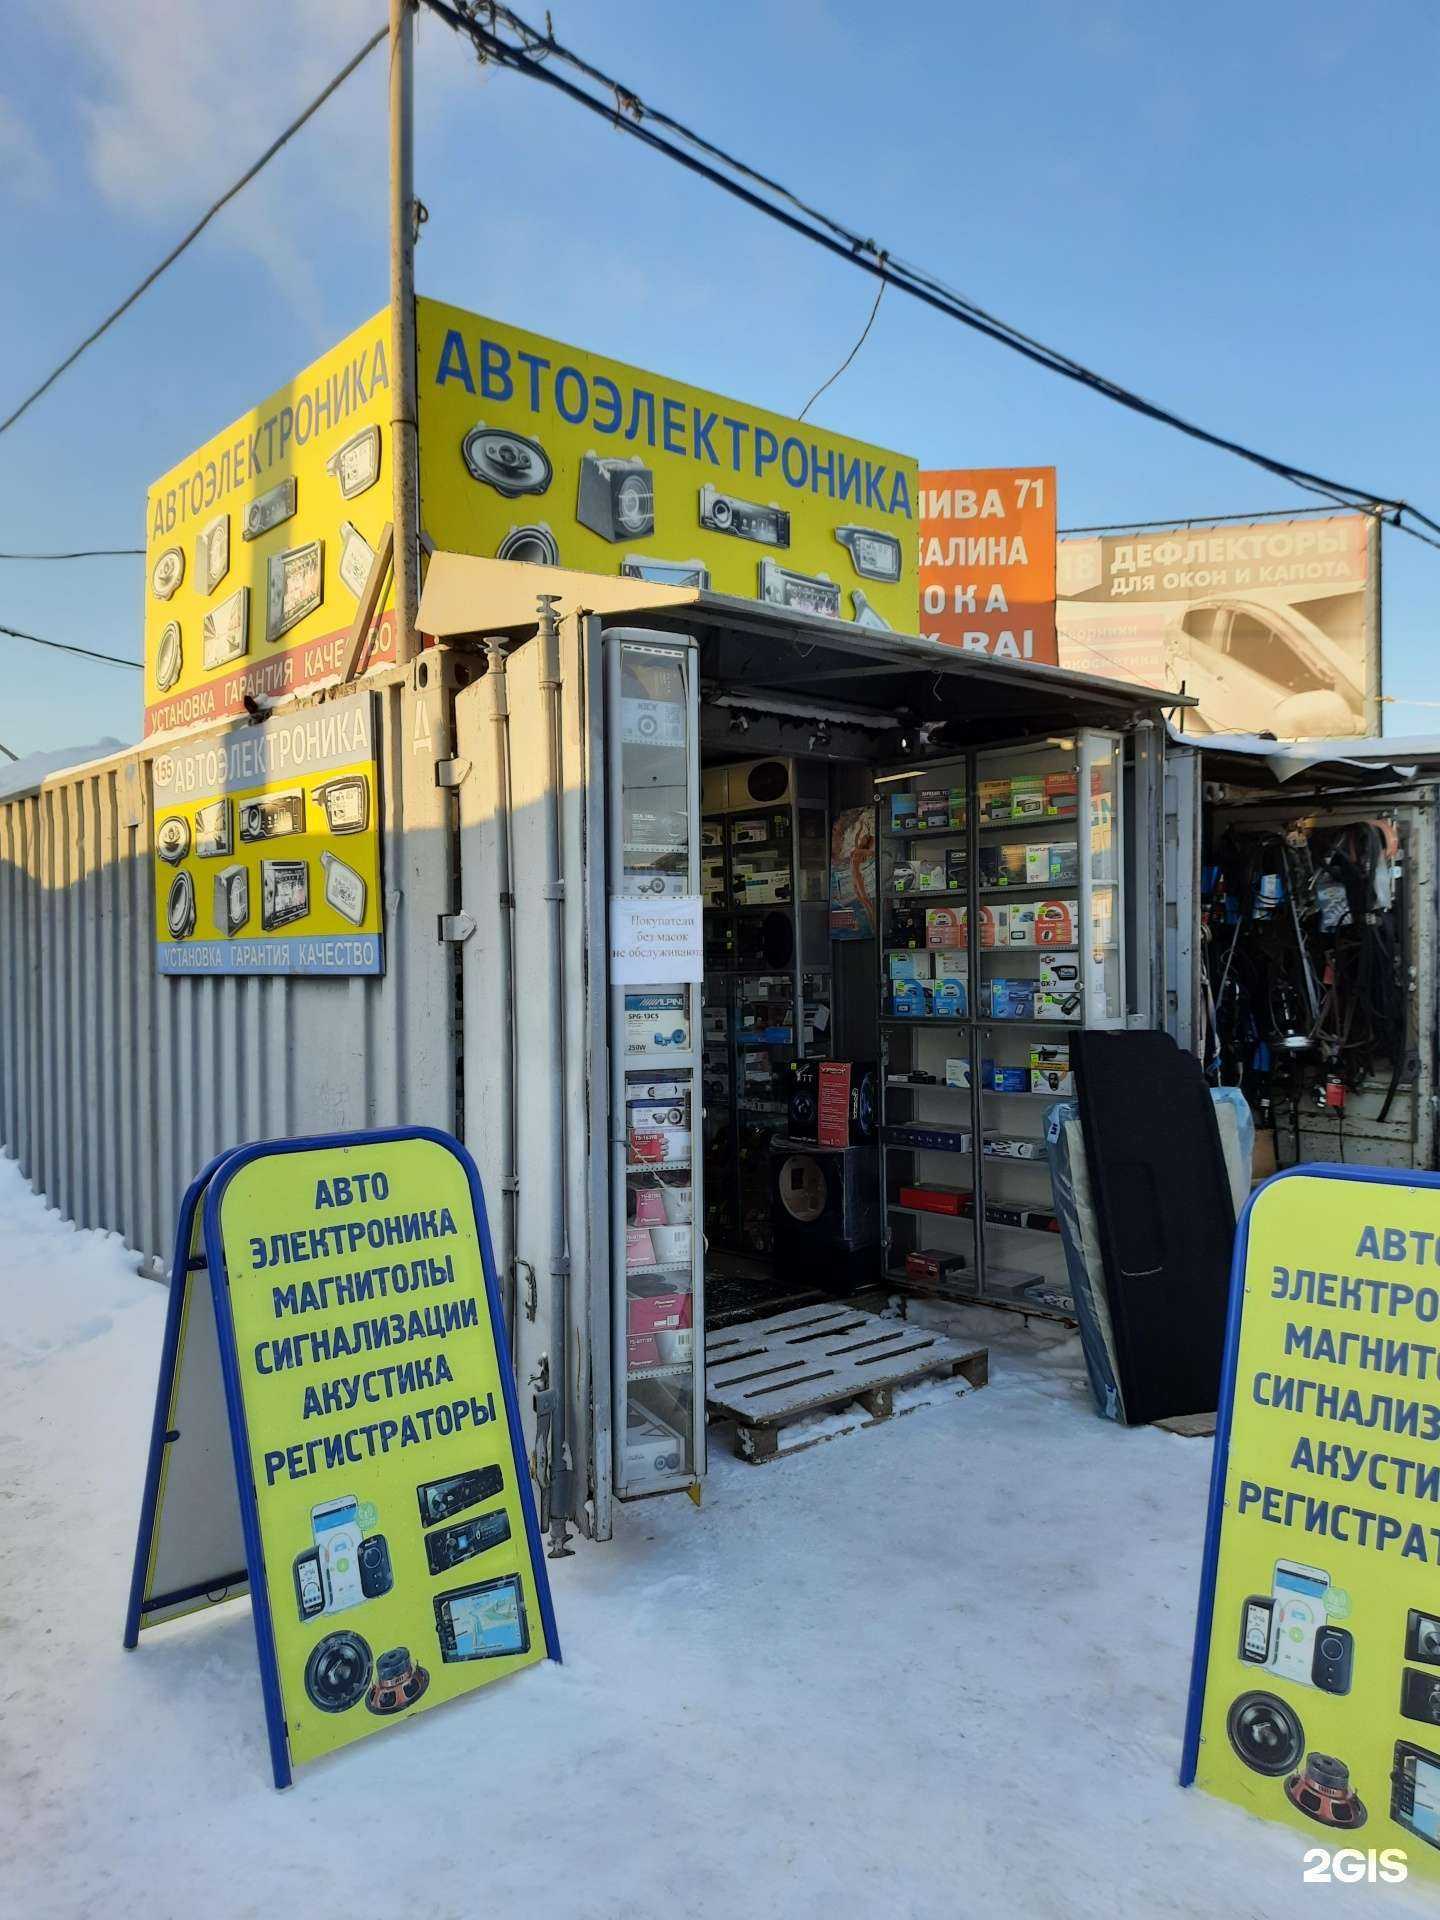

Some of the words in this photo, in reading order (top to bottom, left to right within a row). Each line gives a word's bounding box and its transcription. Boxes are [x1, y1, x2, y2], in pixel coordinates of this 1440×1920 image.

[153, 340, 389, 541] АВТОЭЛЕКТРОНИКА
[436, 329, 913, 520] АВТОЭЛЕКТРОНИКА
[1013, 478, 1044, 509] 71
[1110, 528, 1348, 574] ДЕФЛЕКТОРЫ
[1163, 569, 1227, 590] ОКОН
[1234, 567, 1250, 584] И
[1258, 560, 1351, 582] КАПОТА
[924, 584, 1009, 614] ОКА
[151, 689, 215, 733] УСТАНОВКА
[223, 657, 294, 707] ГАРАНТИЯ
[304, 622, 392, 678] КАЧЕВО
[175, 708, 369, 793] АВТОЭЛЕКТРОНИКА
[164, 946, 223, 967] УСТАНОВКА
[230, 944, 290, 967] ГАРАНТИЯ
[299, 941, 374, 966] КАЧЕСТВО
[315, 1171, 389, 1210] АВТО
[249, 1207, 458, 1269] ЭЛЕКТРОНИКА
[1355, 1225, 1440, 1267] АВТ
[273, 1255, 454, 1318] МАГНИТОЛЫ
[1270, 1266, 1440, 1323] ЭЛЕКТРО
[254, 1298, 479, 1375] СИГНАЛИЗАЦИИ
[1284, 1322, 1440, 1381] МАГНИТ
[302, 1353, 454, 1420] АКУСТИКА
[1252, 1371, 1440, 1441] СИГНАЛИЗ
[264, 1392, 497, 1486] РЕГИСТРАТОРЫ
[1290, 1436, 1440, 1502] АКУСТИ
